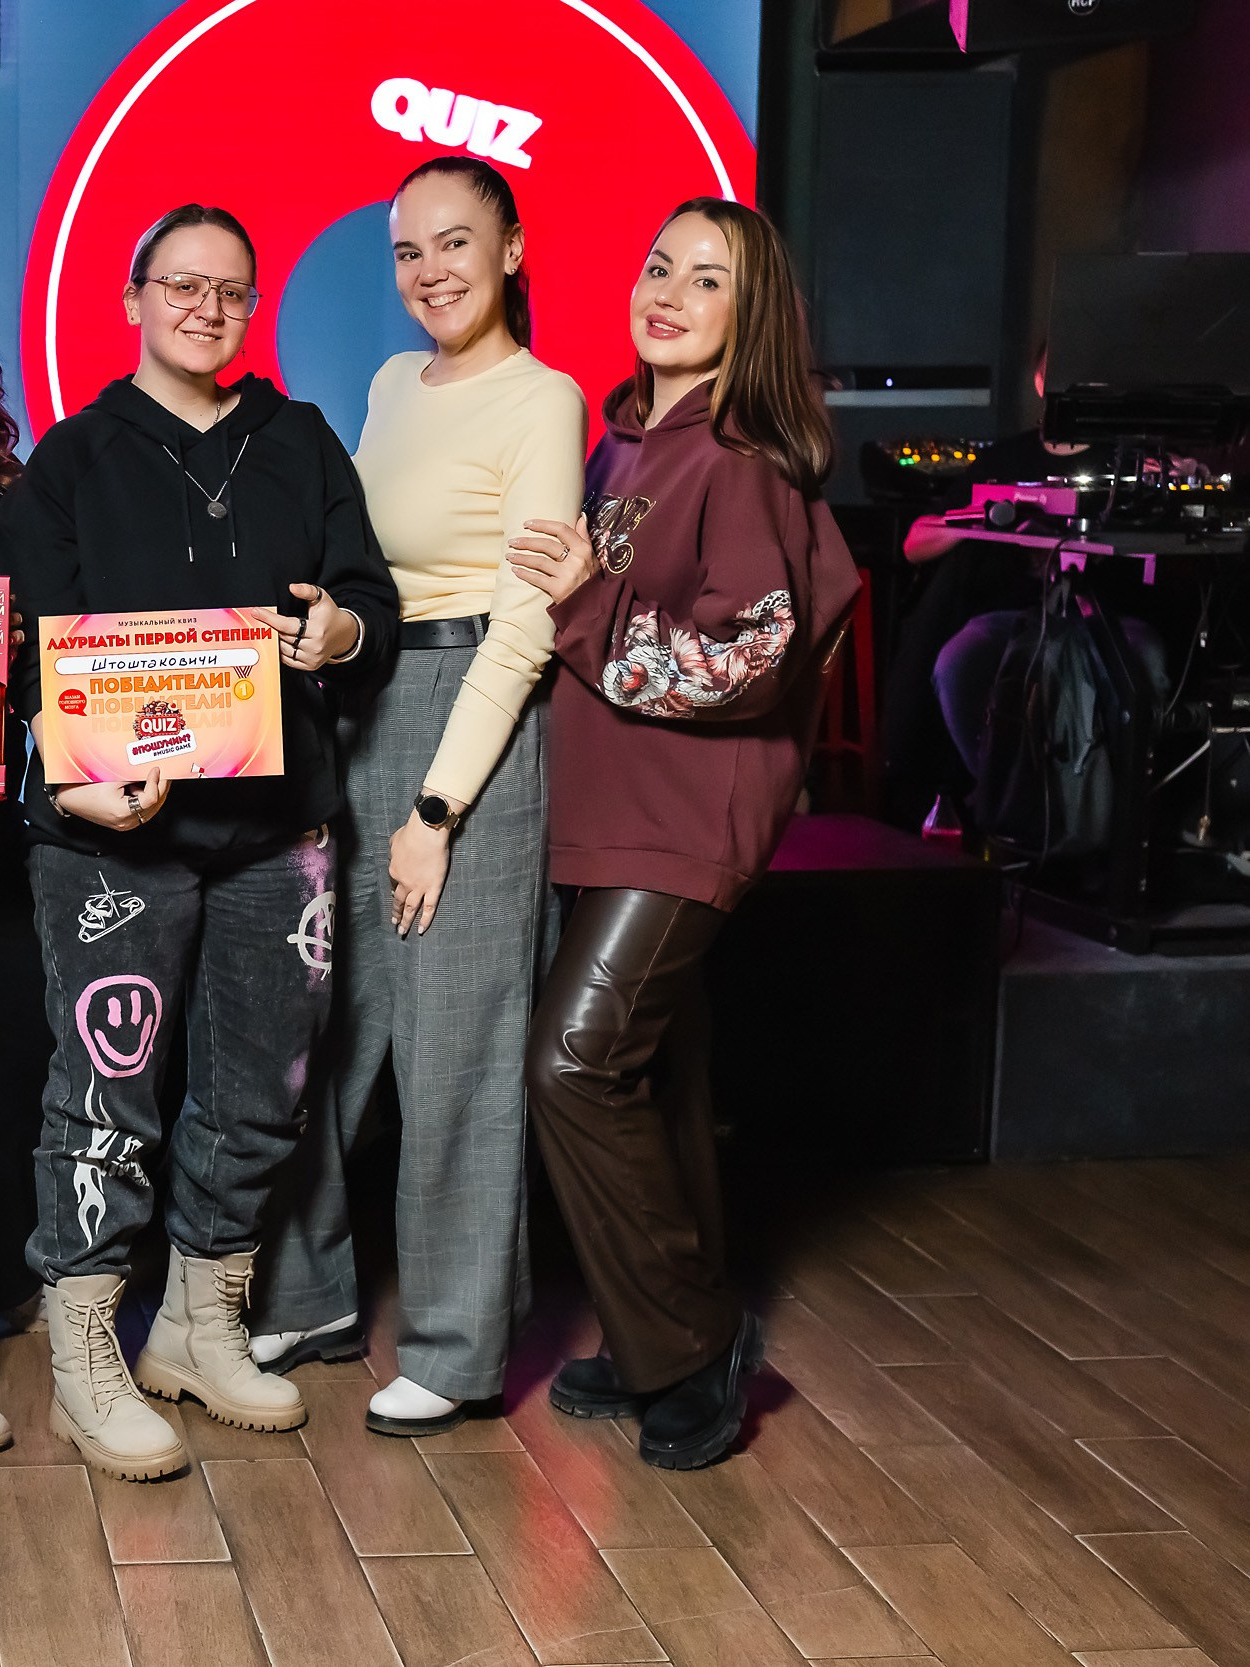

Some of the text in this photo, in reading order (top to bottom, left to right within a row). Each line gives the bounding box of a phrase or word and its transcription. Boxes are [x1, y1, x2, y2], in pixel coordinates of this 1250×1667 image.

[371, 77, 543, 169] QUIZ
[118, 617, 176, 626] МУЗЫКАЛЬНЫЙ
[47, 627, 272, 650] ЛАУРЕАТЫ ПЕРВОЙ СТЕПЕНИ
[92, 655, 217, 671] Штоштаковичи
[90, 672, 230, 694] ПОБЕДИТЕЛИ!
[140, 717, 178, 733] QUIZ
